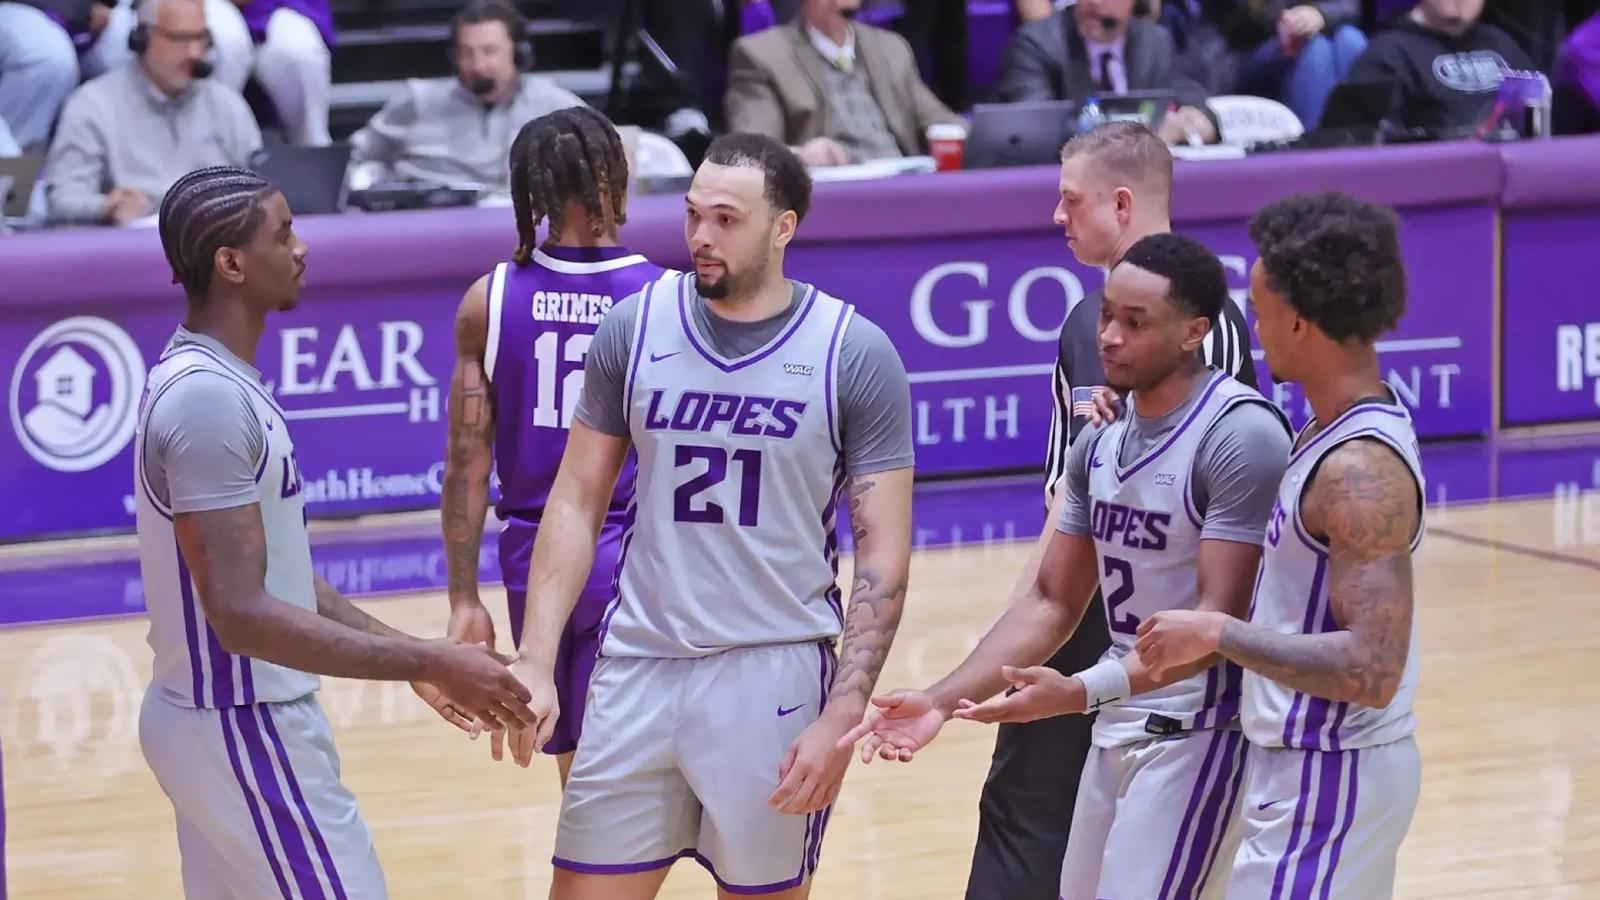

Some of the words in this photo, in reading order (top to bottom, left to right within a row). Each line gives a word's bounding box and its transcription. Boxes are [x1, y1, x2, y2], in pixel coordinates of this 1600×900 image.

[532, 290, 614, 325] GRIMES
[265, 319, 437, 395] EAR
[533, 331, 594, 429] 12
[783, 363, 814, 376] WAC
[645, 389, 807, 440] LOPES
[673, 444, 762, 527] 21
[1104, 555, 1141, 635] 2
